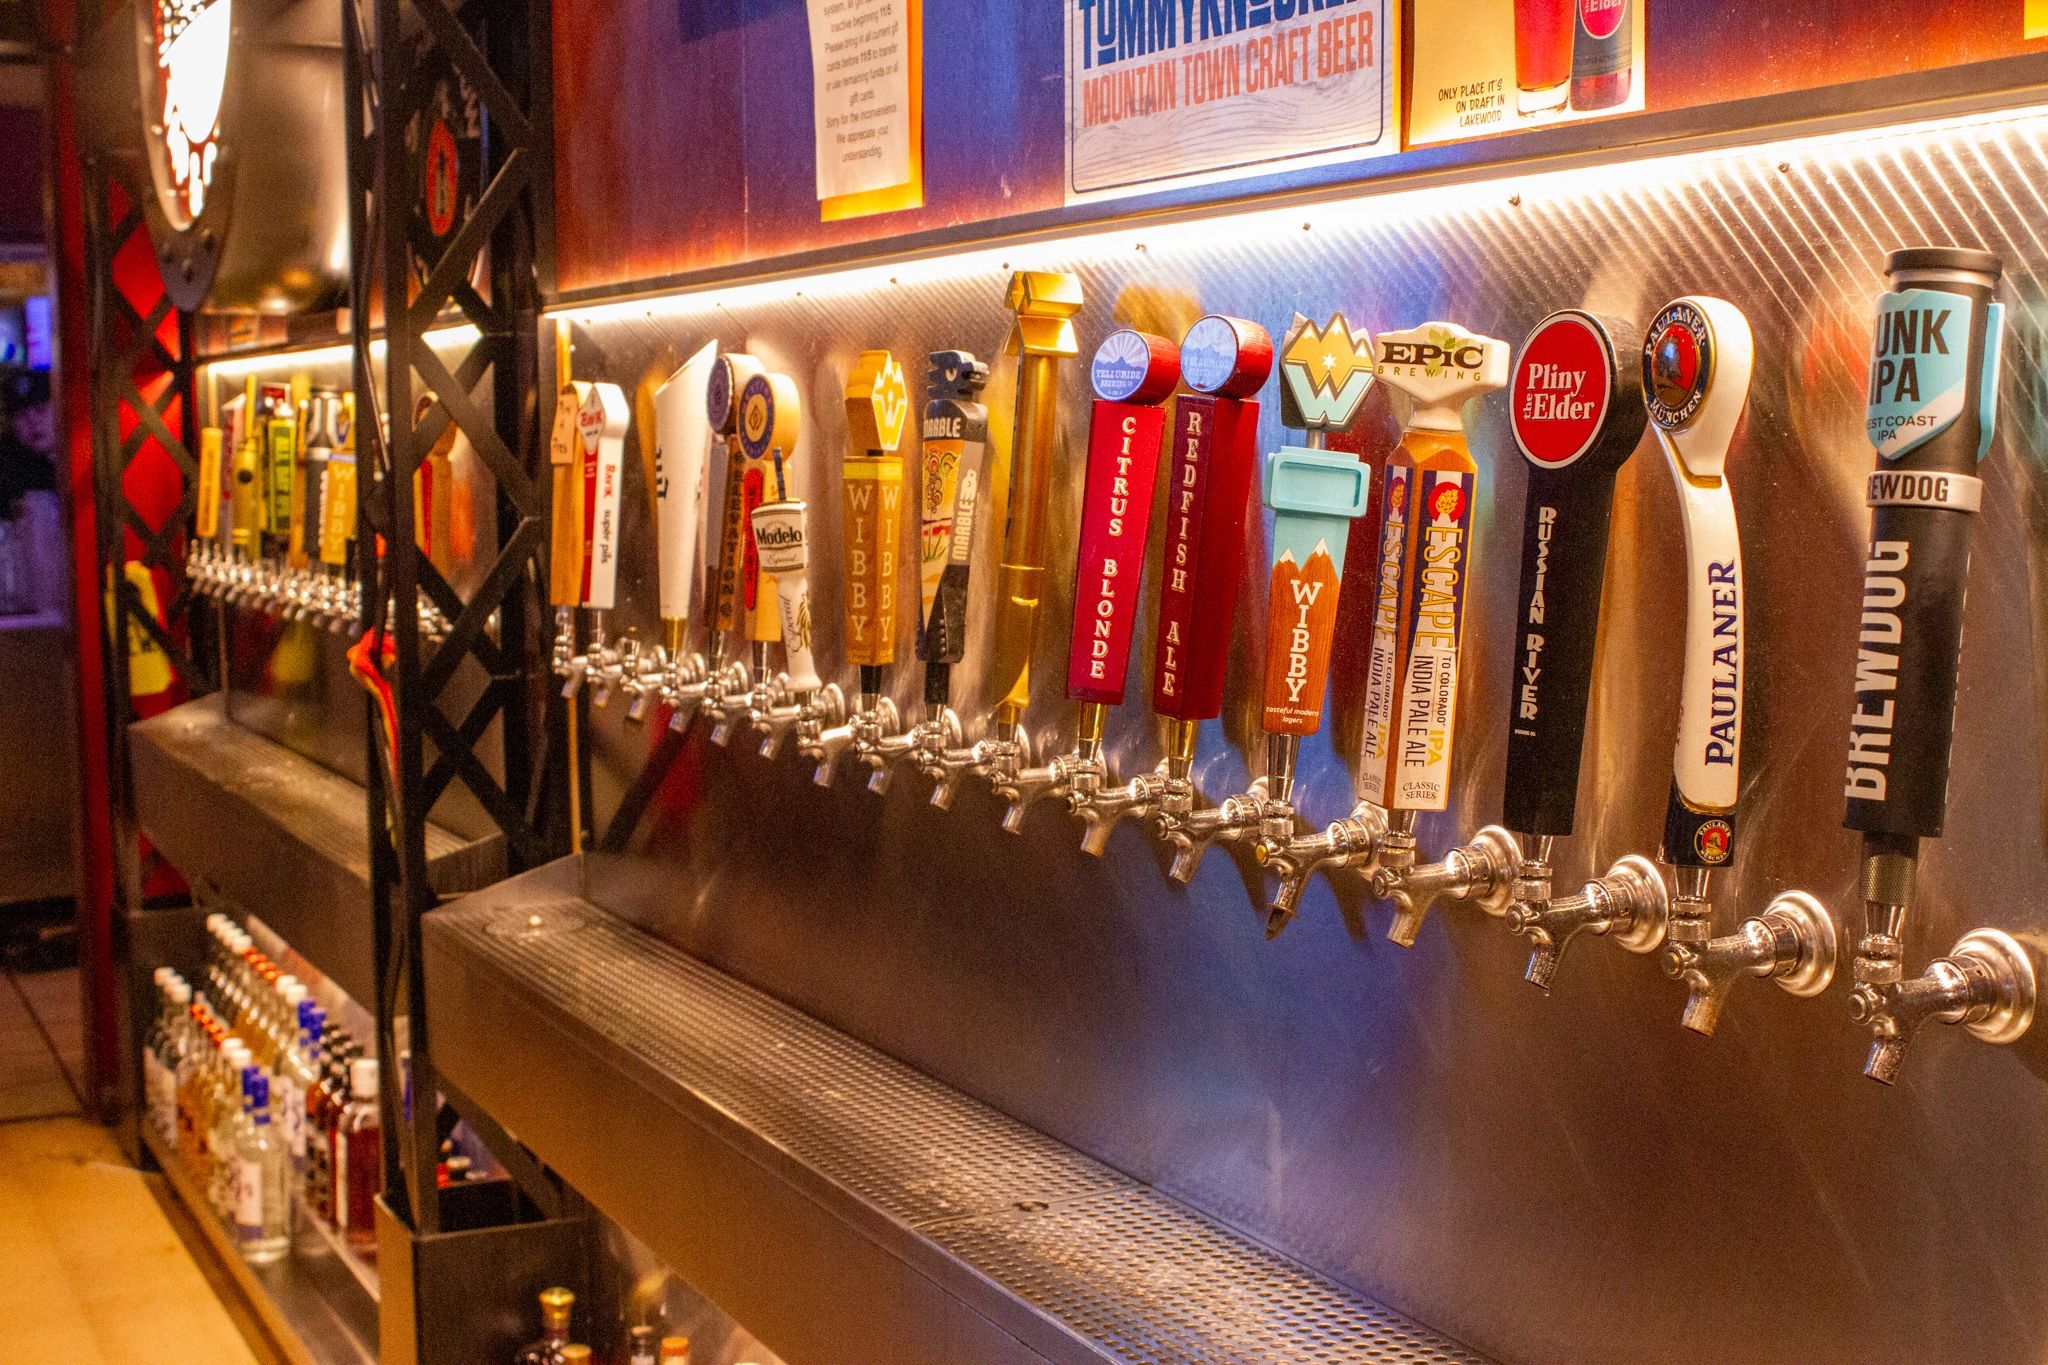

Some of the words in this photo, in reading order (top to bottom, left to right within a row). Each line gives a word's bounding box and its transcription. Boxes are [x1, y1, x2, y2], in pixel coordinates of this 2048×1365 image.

[1079, 0, 1357, 70] TOMMYK
[1083, 58, 1177, 128] MOUNTAIN
[1183, 43, 1240, 106] TOWN
[1246, 25, 1312, 93] CRAFT
[1317, 10, 1374, 79] BEER
[1438, 87, 1458, 101] ONLY
[1460, 81, 1485, 98] PLACE
[1488, 78, 1503, 93] IT'S
[1455, 101, 1467, 113] ON
[1469, 95, 1495, 112] DRAFT
[1497, 93, 1506, 107] IN
[1459, 109, 1502, 128] LAKEWOOD
[1645, 306, 1706, 356] PAULANER
[1872, 309, 1951, 358] UNK
[1096, 369, 1142, 380] TELLURIDE
[1377, 366, 1481, 381] BREWING
[1526, 363, 1587, 397] Pliny
[1869, 357, 1920, 406] IPA
[1523, 392, 1533, 419] the
[1531, 393, 1595, 420] Elder
[1866, 416, 1883, 430] EST
[1884, 415, 1938, 427] COAST
[1877, 430, 1898, 440] IPA
[1108, 416, 1137, 537] CITRUS
[1868, 474, 1949, 502] EWDOG
[1170, 411, 1203, 593] REDFISH
[601, 509, 612, 542] super
[756, 526, 803, 545] Modelo
[951, 499, 976, 561] MARBLE
[600, 543, 612, 564] pils
[847, 484, 872, 641] WIBBY
[880, 485, 899, 642] WIBBY
[1528, 506, 1557, 625] RUSSIAN
[1375, 520, 1405, 643] ESCAPE
[1415, 526, 1464, 648] ESCAPE
[1089, 558, 1119, 680] BLONDE
[1162, 620, 1181, 697] ALE
[1285, 579, 1324, 703] WIBBY
[1387, 651, 1394, 664] TO
[1370, 647, 1385, 687] INDIA
[1411, 655, 1434, 695] INDIA
[1441, 656, 1452, 669] TO
[1520, 633, 1545, 721] RIVER
[1704, 558, 1738, 767] PAULANER
[1265, 706, 1294, 716] tasteful
[1293, 708, 1320, 718] modern
[1367, 690, 1381, 729] PALE
[1381, 666, 1393, 720] COLORADO
[1437, 670, 1450, 725] COLORADO
[1282, 715, 1303, 725] lagers
[1407, 699, 1430, 737] PALE
[1363, 731, 1377, 760] ALE
[1375, 723, 1388, 760] IPA
[1404, 740, 1427, 768] ALE
[1426, 729, 1445, 767] IPA
[1362, 772, 1383, 786] CLASSIC
[1402, 781, 1441, 792] CLASSIC
[1405, 791, 1438, 801] SERIES
